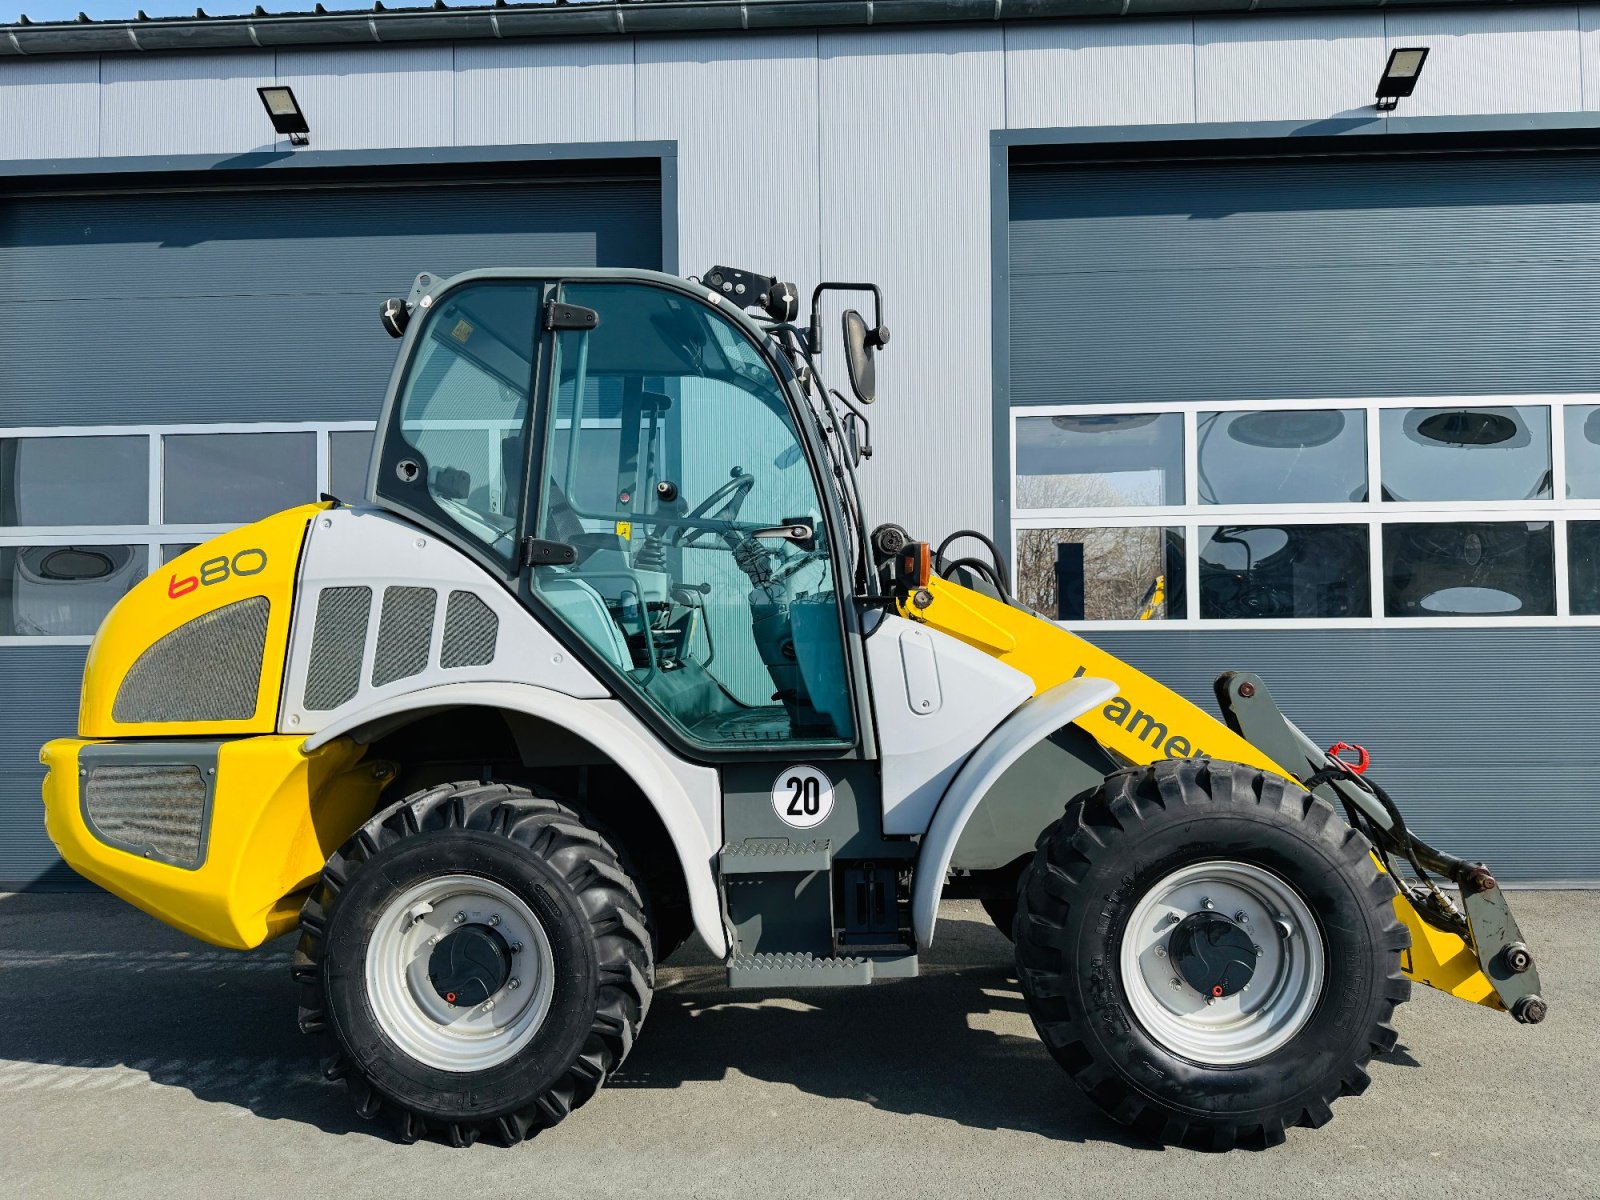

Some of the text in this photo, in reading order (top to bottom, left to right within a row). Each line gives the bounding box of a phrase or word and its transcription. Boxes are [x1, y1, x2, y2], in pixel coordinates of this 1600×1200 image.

[168, 549, 267, 599] 680
[1073, 665, 1212, 759] ame
[787, 777, 819, 815] 20
